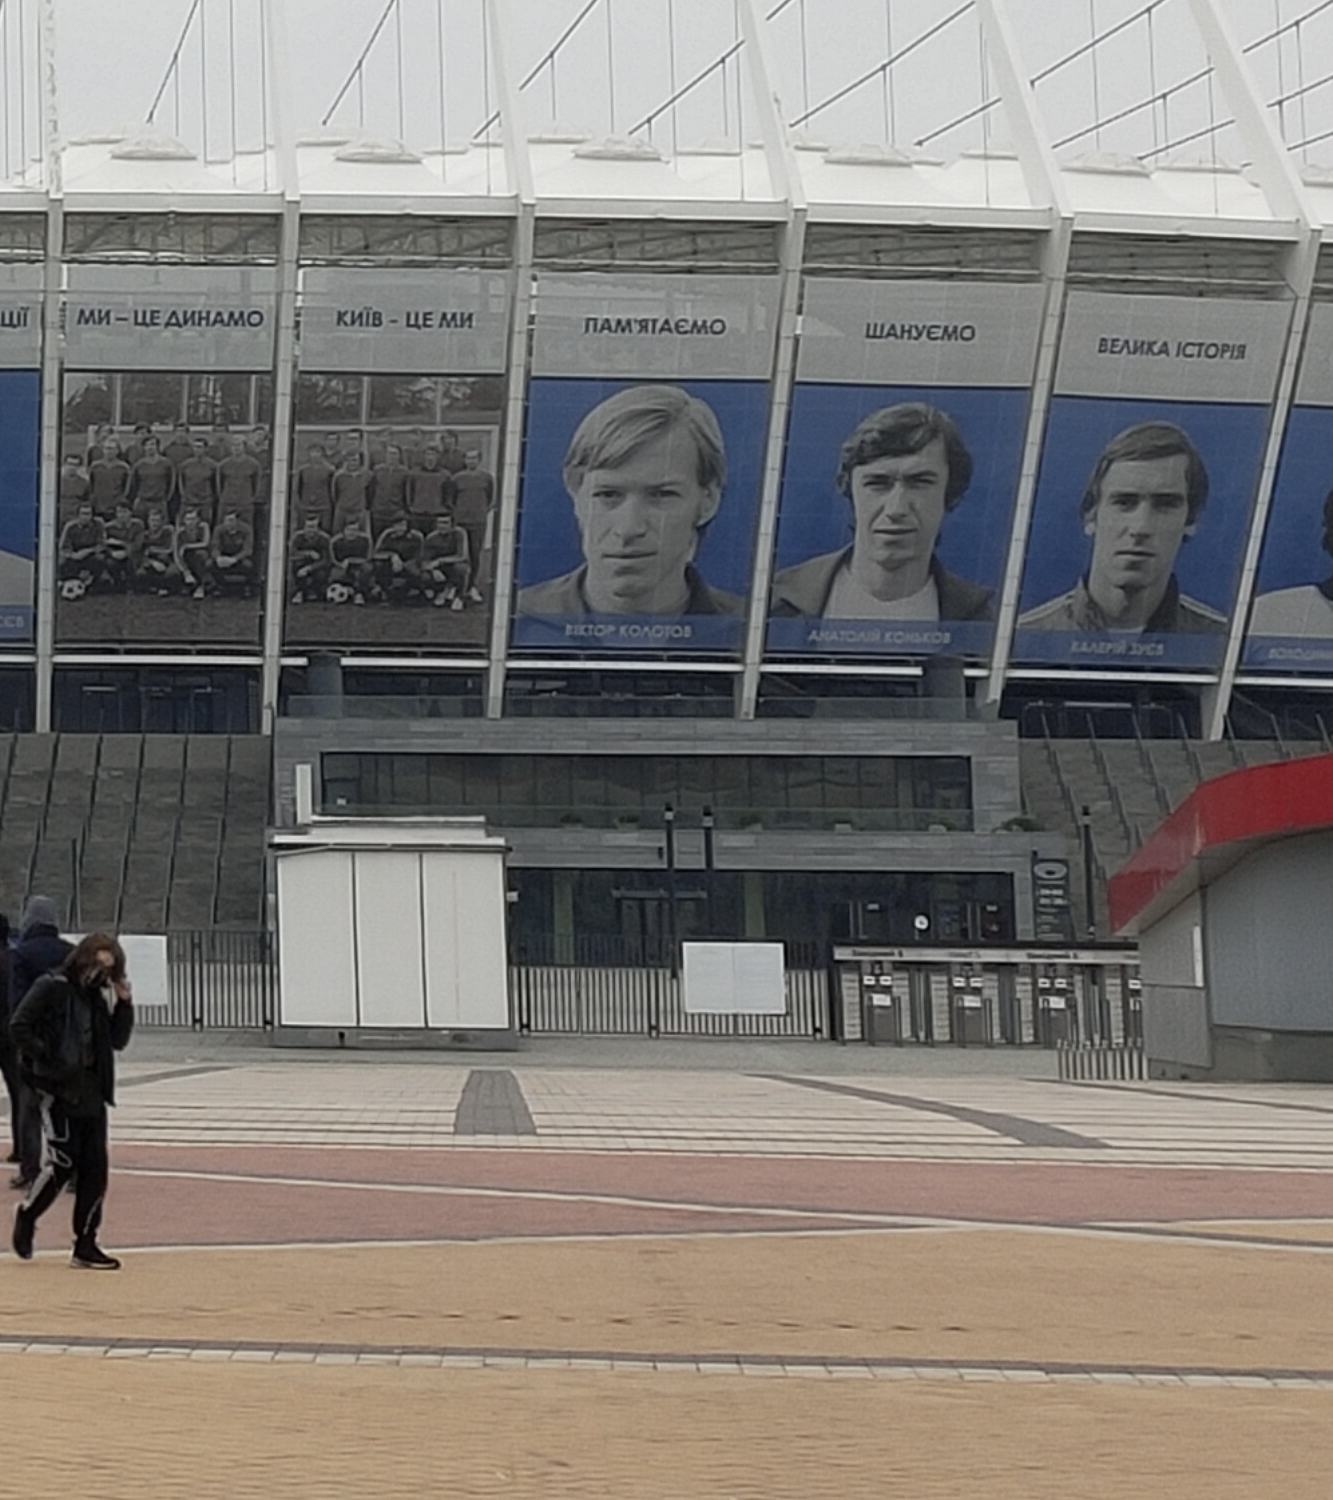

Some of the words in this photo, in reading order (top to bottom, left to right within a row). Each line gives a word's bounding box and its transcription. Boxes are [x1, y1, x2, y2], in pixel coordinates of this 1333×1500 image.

[76, 308, 112, 327] МИ
[133, 310, 161, 329] ЦЕ
[164, 310, 264, 329] ДИНАМО
[336, 306, 383, 328] КИЇВ
[405, 311, 434, 330] ЦЕ
[438, 311, 474, 329] МИ
[865, 322, 976, 342] ШАНУЄМО
[1098, 337, 1170, 357] ВЕЛИКА
[1175, 341, 1247, 361] ІСТОРІЯ
[619, 624, 692, 638] КОЛОТОВ
